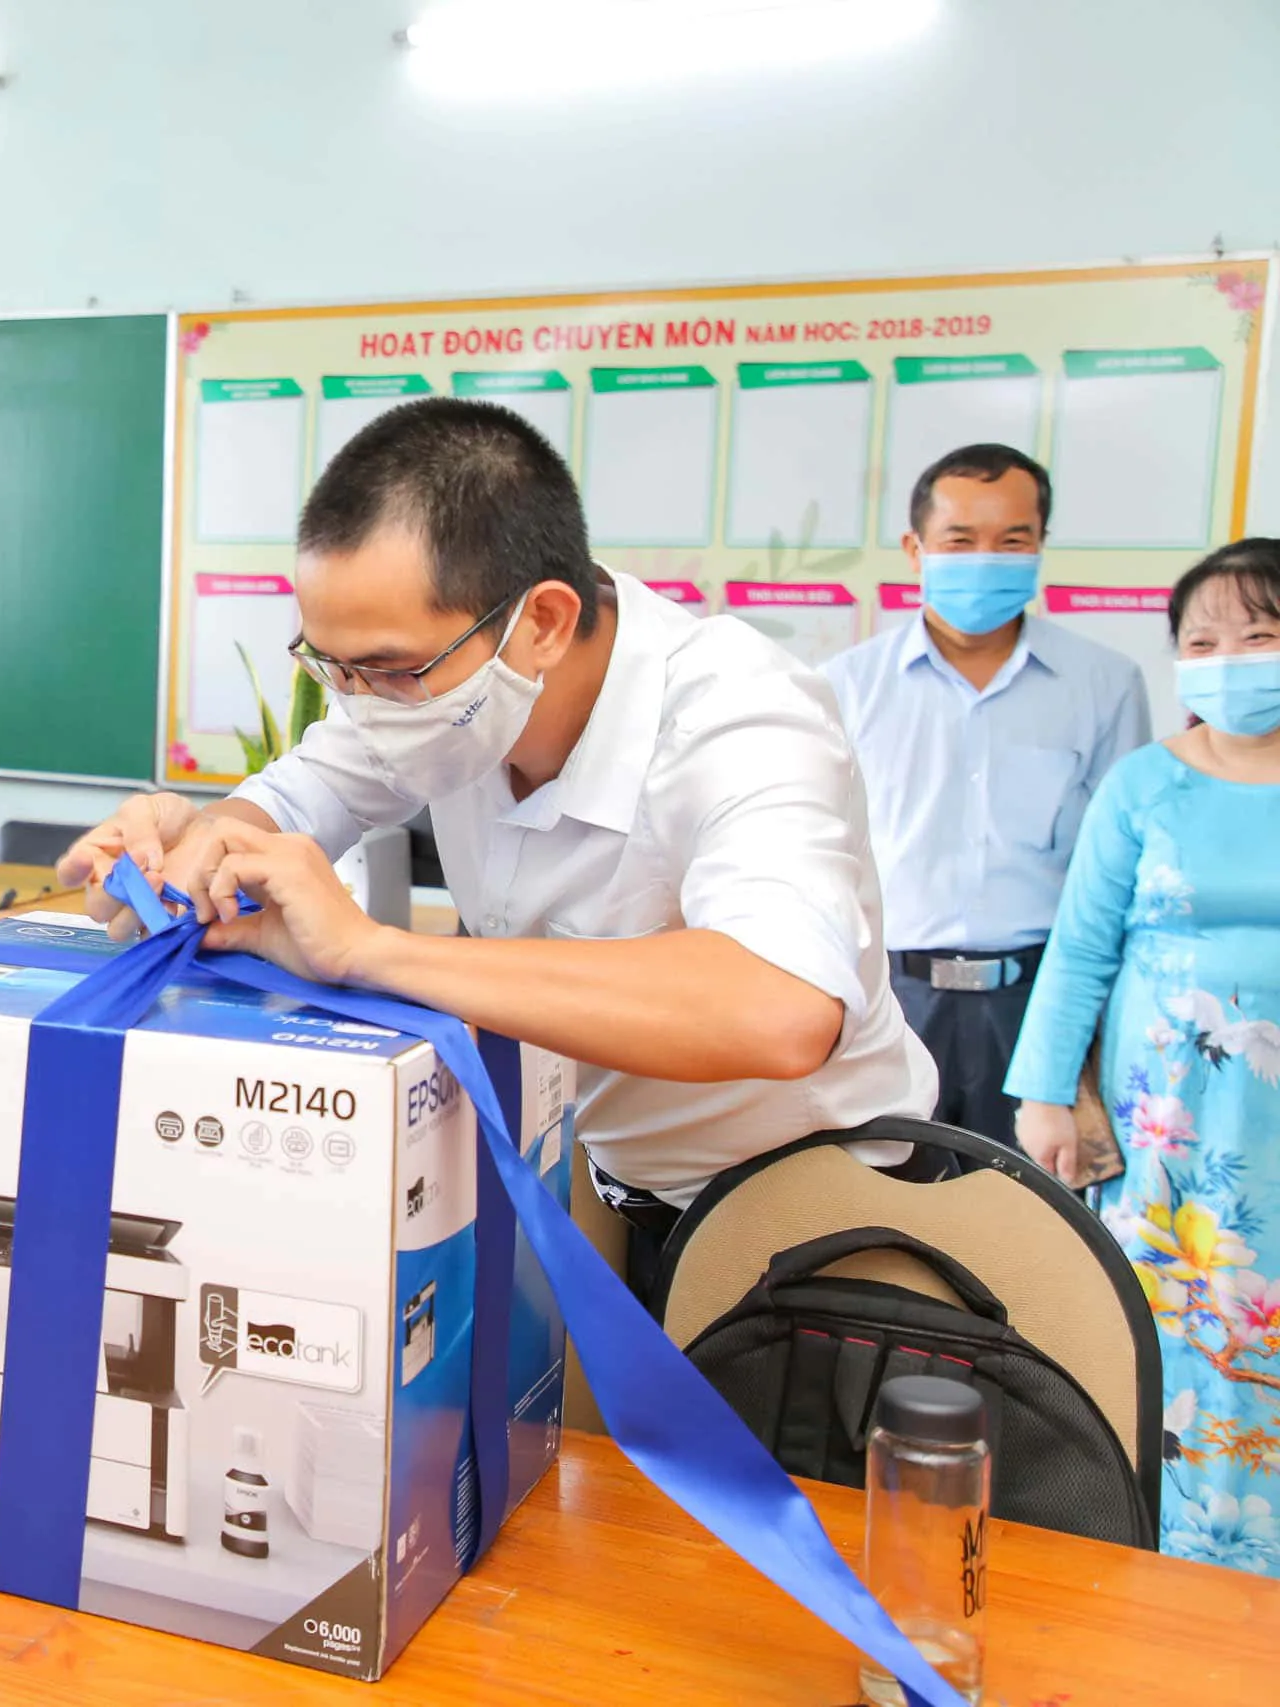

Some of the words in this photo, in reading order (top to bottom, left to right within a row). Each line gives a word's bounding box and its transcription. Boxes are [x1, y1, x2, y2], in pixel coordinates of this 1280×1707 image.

[867, 315, 991, 340] 2018-2019
[236, 1077, 356, 1121] M2140
[246, 1328, 350, 1368] ecotank
[319, 1620, 361, 1645] 6,000
